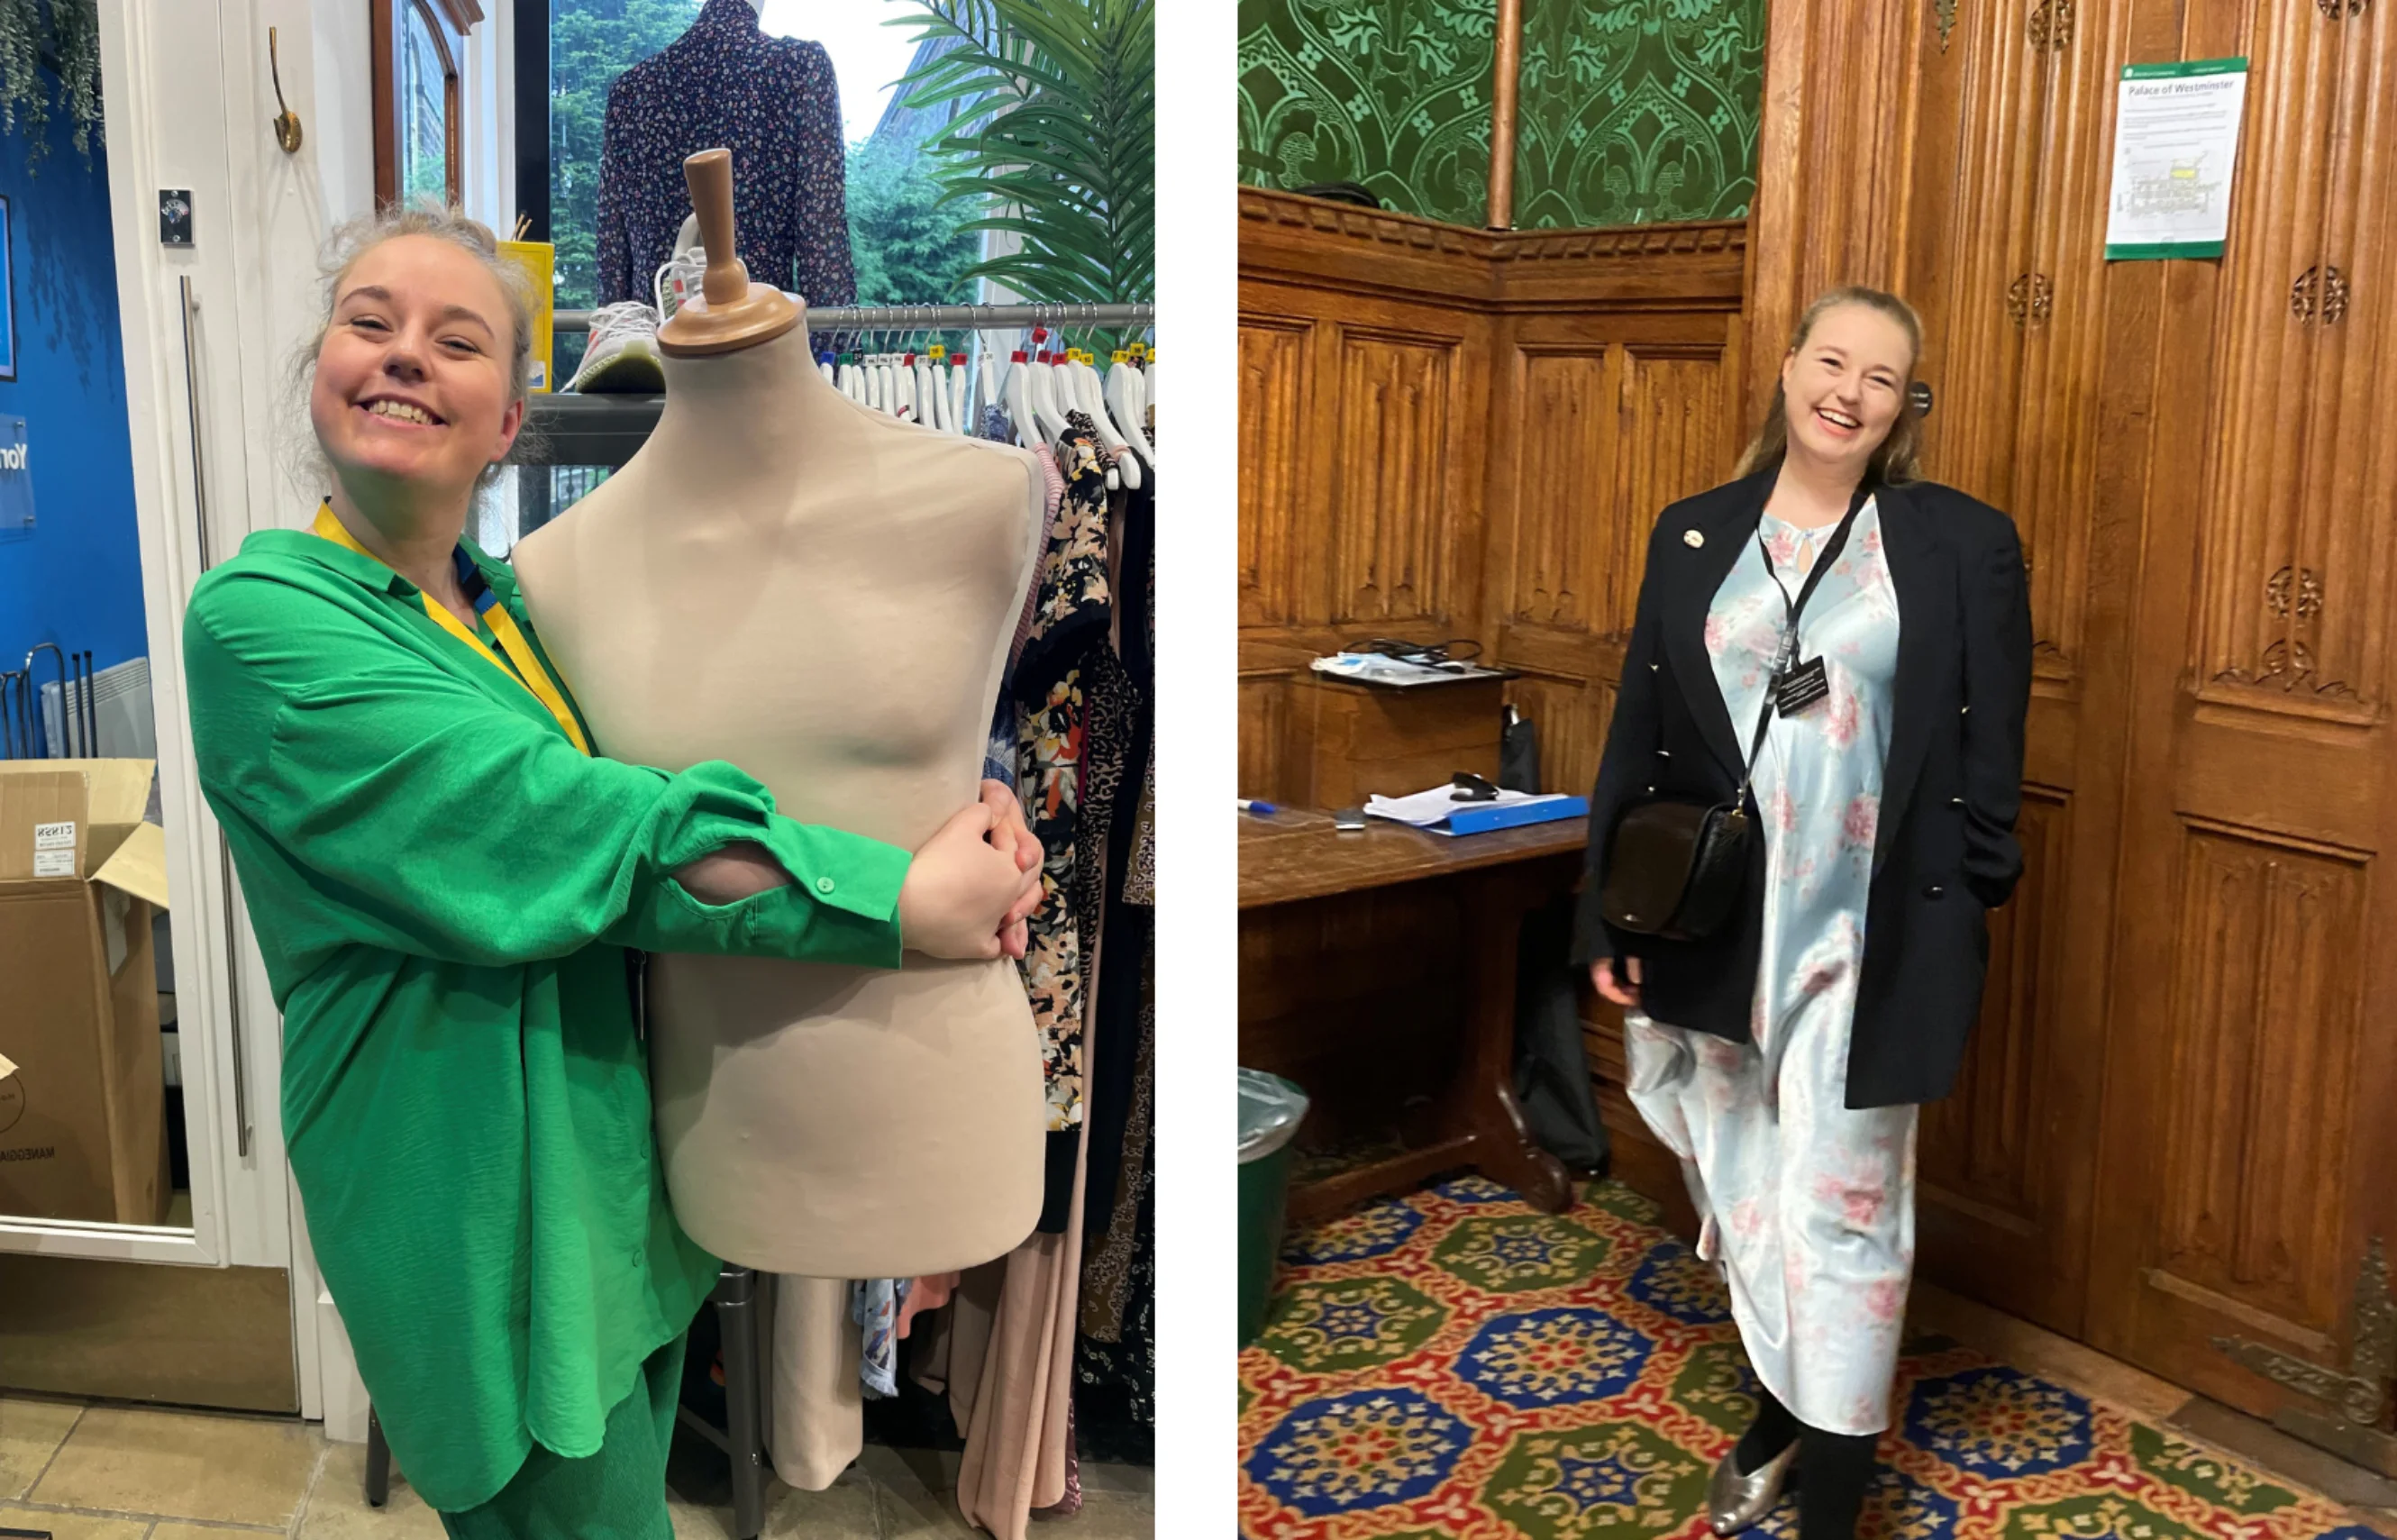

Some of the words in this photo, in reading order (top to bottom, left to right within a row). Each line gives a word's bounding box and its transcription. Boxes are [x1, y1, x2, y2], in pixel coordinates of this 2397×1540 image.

[2128, 85, 2160, 96] Palace
[2162, 84, 2174, 94] of
[2174, 80, 2235, 93] Westminster
